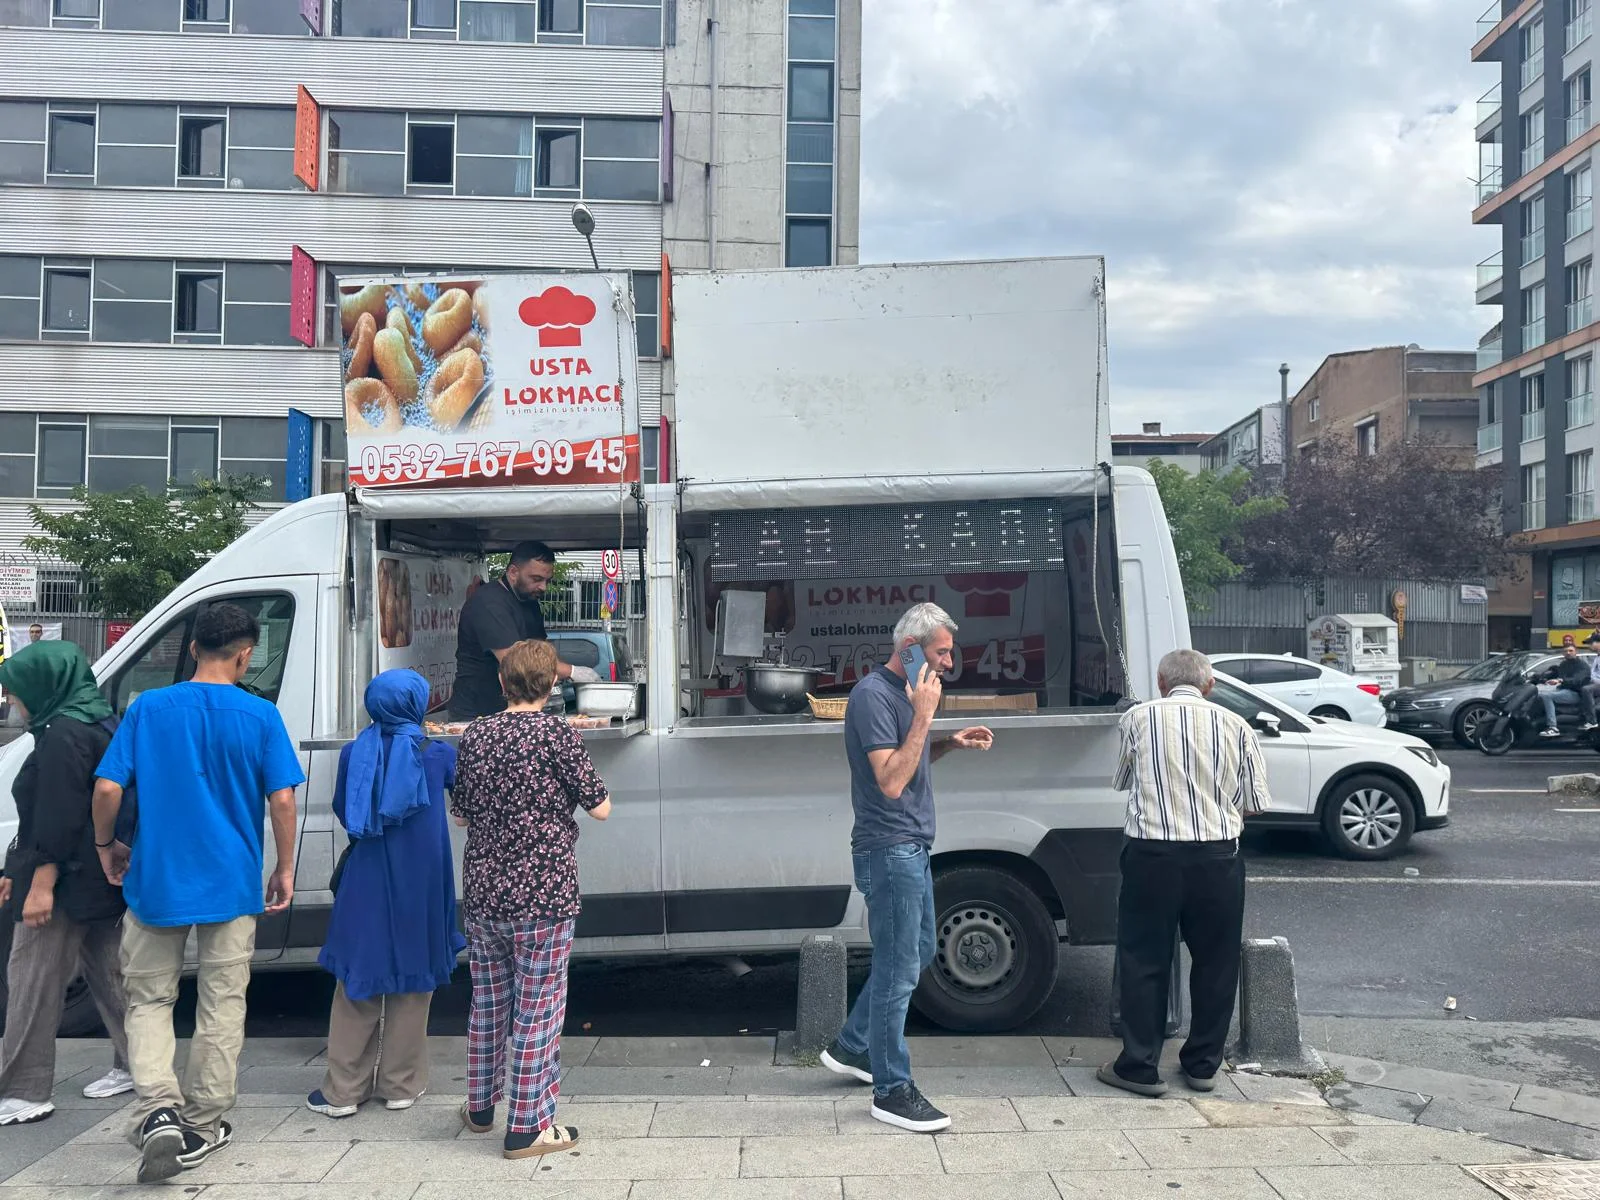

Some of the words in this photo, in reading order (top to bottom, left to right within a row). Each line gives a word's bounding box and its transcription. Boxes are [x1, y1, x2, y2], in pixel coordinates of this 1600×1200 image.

[529, 357, 592, 376] USTA
[504, 385, 622, 406] LOKMACI
[506, 406, 557, 416] işimizin
[360, 443, 446, 482] 0532
[456, 440, 521, 478] 767
[531, 438, 574, 476] 99
[585, 437, 628, 474] 45
[605, 553, 616, 569] 30
[808, 584, 936, 607] LOKMACI
[977, 638, 1027, 681] 45
